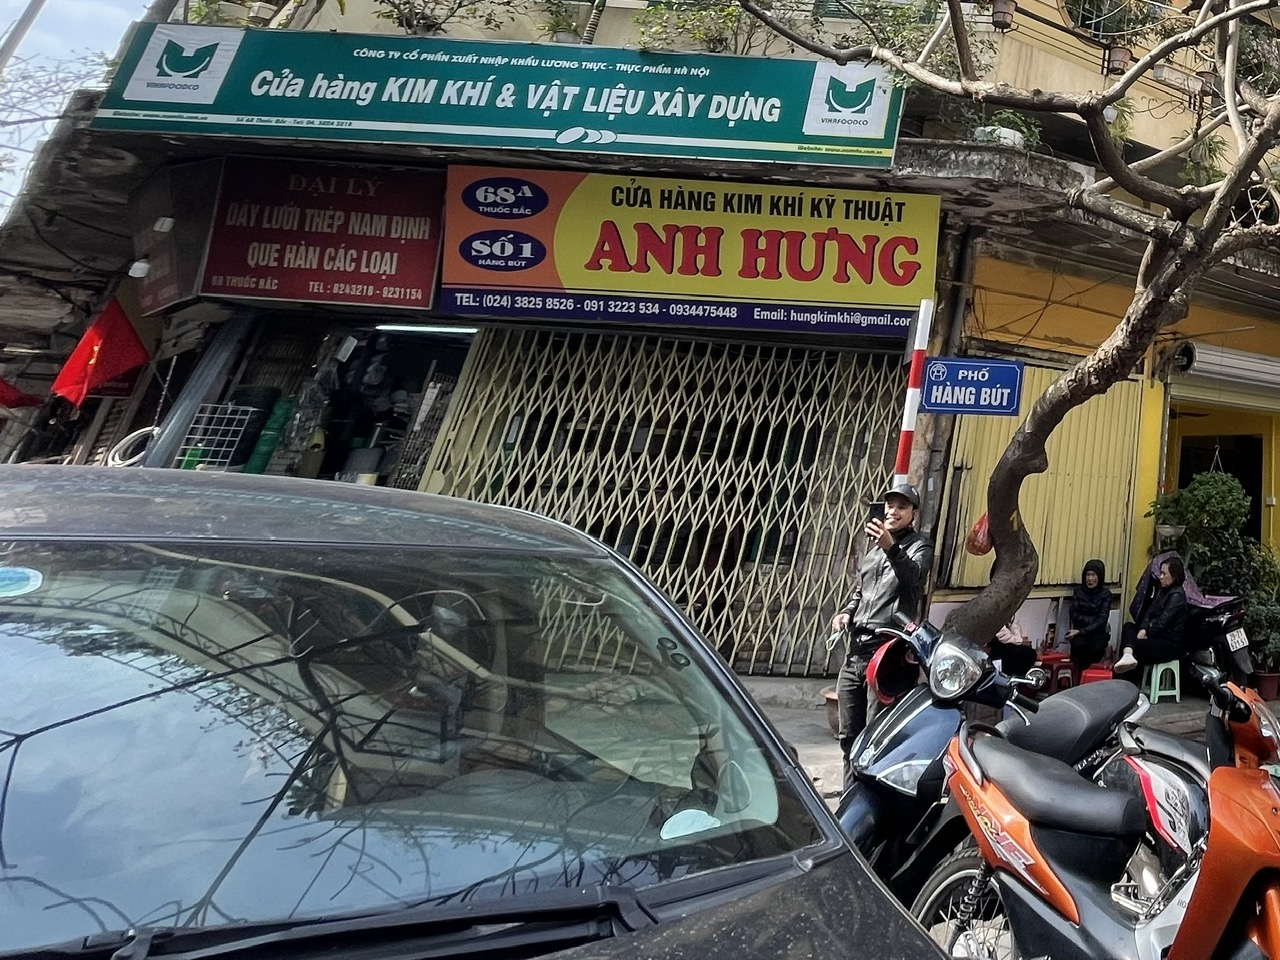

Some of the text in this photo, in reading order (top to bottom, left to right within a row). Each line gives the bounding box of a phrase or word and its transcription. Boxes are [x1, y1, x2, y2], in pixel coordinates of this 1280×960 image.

[353, 48, 385, 59] CÔNG
[388, 51, 401, 59] TY
[541, 60, 579, 70] LƯƠNG
[582, 62, 607, 71] THỰC
[615, 63, 641, 74] THỰC
[690, 67, 710, 78] NỘI
[250, 67, 781, 127] Cửa hàng KIM KHÍ & VẬT LIỆU XÂY DỰNG
[345, 176, 383, 197] LÝ
[611, 178, 906, 227] CỬA HÀNG KIM KHÍ KỸ THUẬT
[305, 205, 345, 234] THÉP
[348, 212, 388, 238] NAM
[390, 216, 431, 244] ĐỊNH
[247, 240, 399, 280] QUE HÀN CÁC LOẠI
[471, 234, 535, 258] SỐ 1
[584, 220, 922, 287] ANH HƯNG
[455, 293, 480, 306] TEL:
[482, 294, 512, 309] (024)
[514, 296, 543, 309] 3825
[545, 298, 574, 310] 8526
[583, 300, 605, 312] 091
[607, 301, 636, 314] 3223
[638, 303, 659, 315] 534
[669, 304, 738, 318] 0934475448
[753, 308, 787, 321] Email:
[958, 367, 990, 382] PHỐ
[930, 381, 1011, 406] HÀNG BÚT
